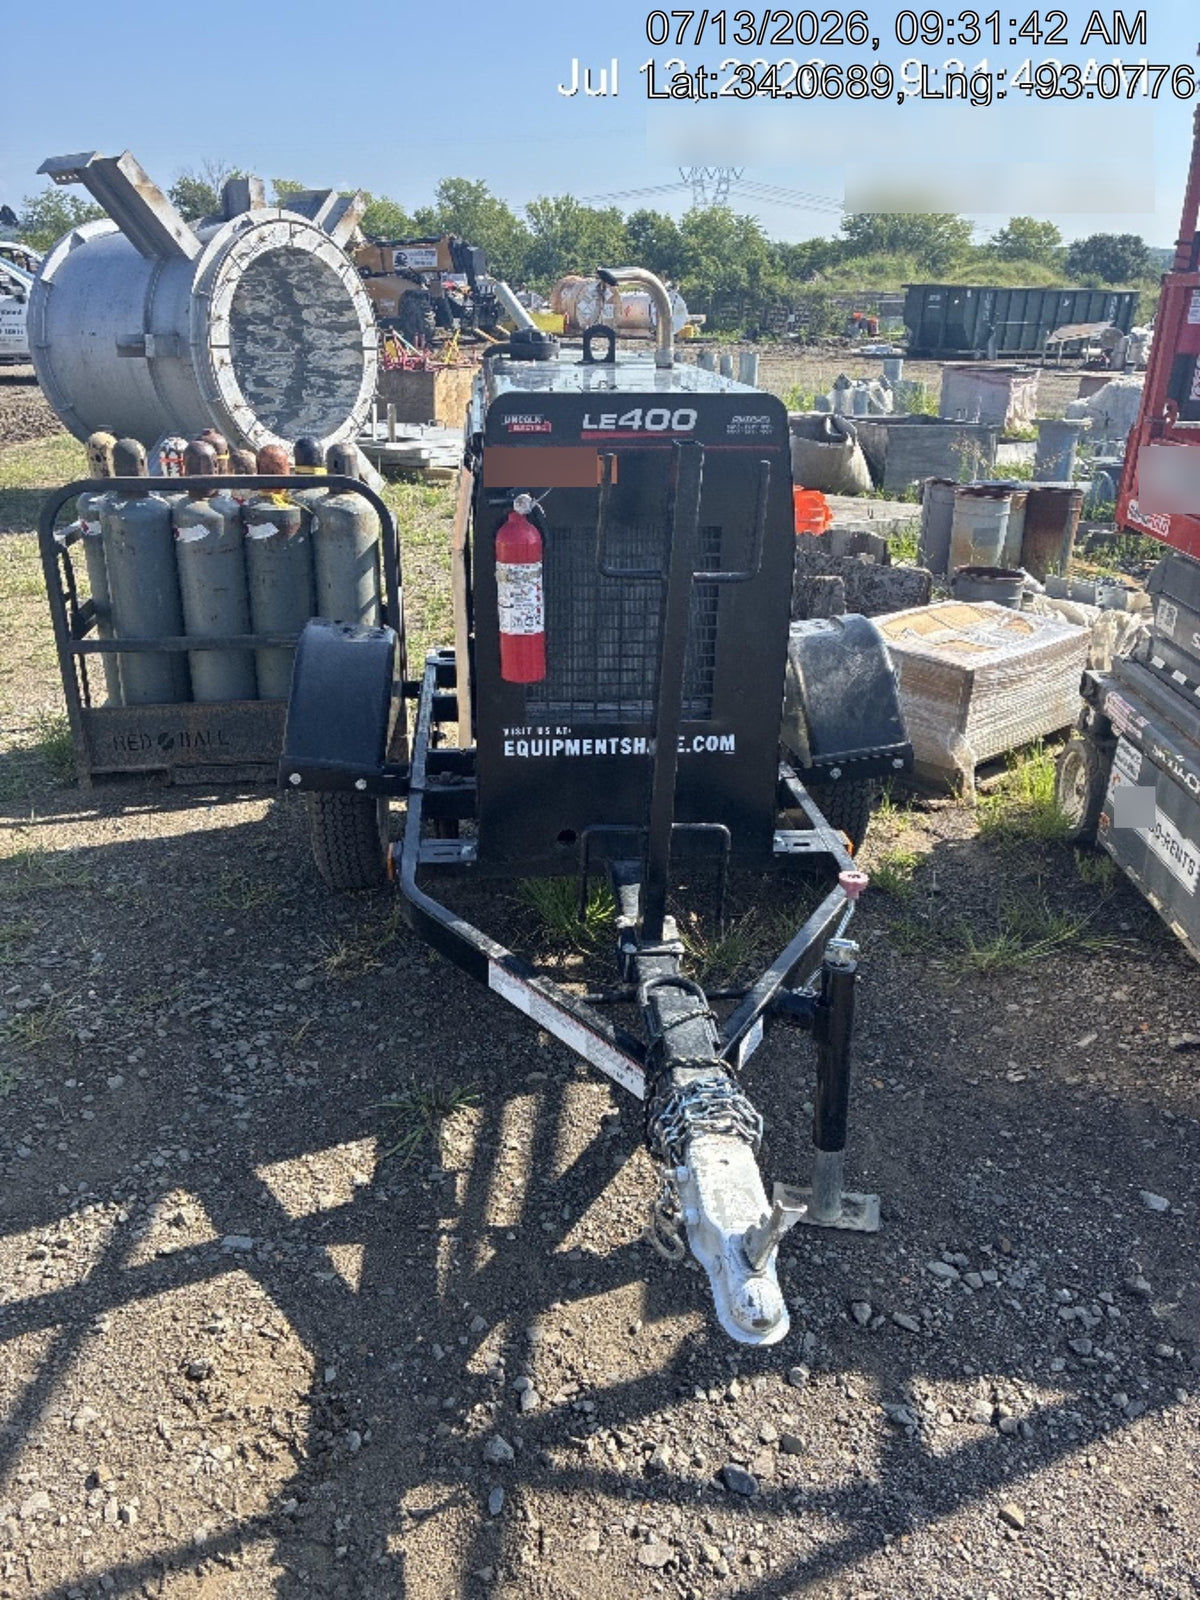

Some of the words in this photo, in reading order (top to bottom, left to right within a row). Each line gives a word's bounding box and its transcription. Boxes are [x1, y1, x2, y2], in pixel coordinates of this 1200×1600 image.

[582, 408, 698, 431] LE400
[113, 732, 152, 752] RED
[503, 734, 736, 758] EQUIPMENTSHE.COM
